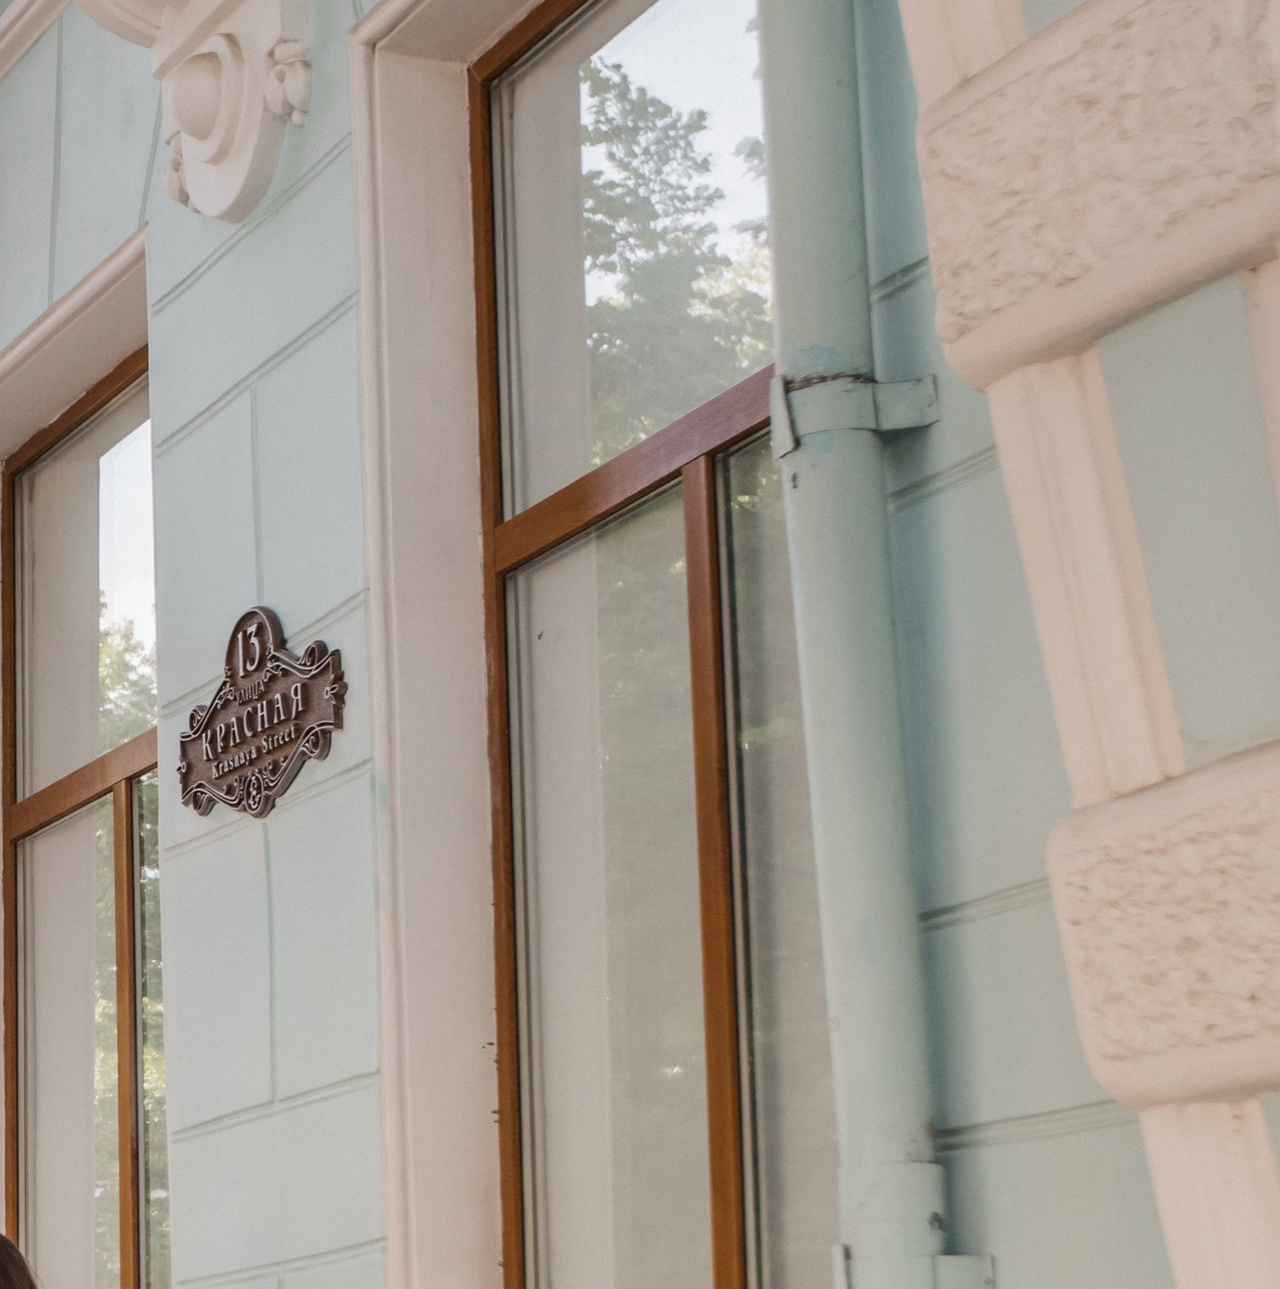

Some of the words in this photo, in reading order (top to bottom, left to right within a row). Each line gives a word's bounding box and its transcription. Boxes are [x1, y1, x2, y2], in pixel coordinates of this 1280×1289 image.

[236, 623, 260, 678] 13
[235, 680, 264, 705] УЛИЦА
[202, 683, 303, 761] КРАСНАЯ
[211, 745, 257, 779] Krasnaya
[261, 726, 296, 753] Street
